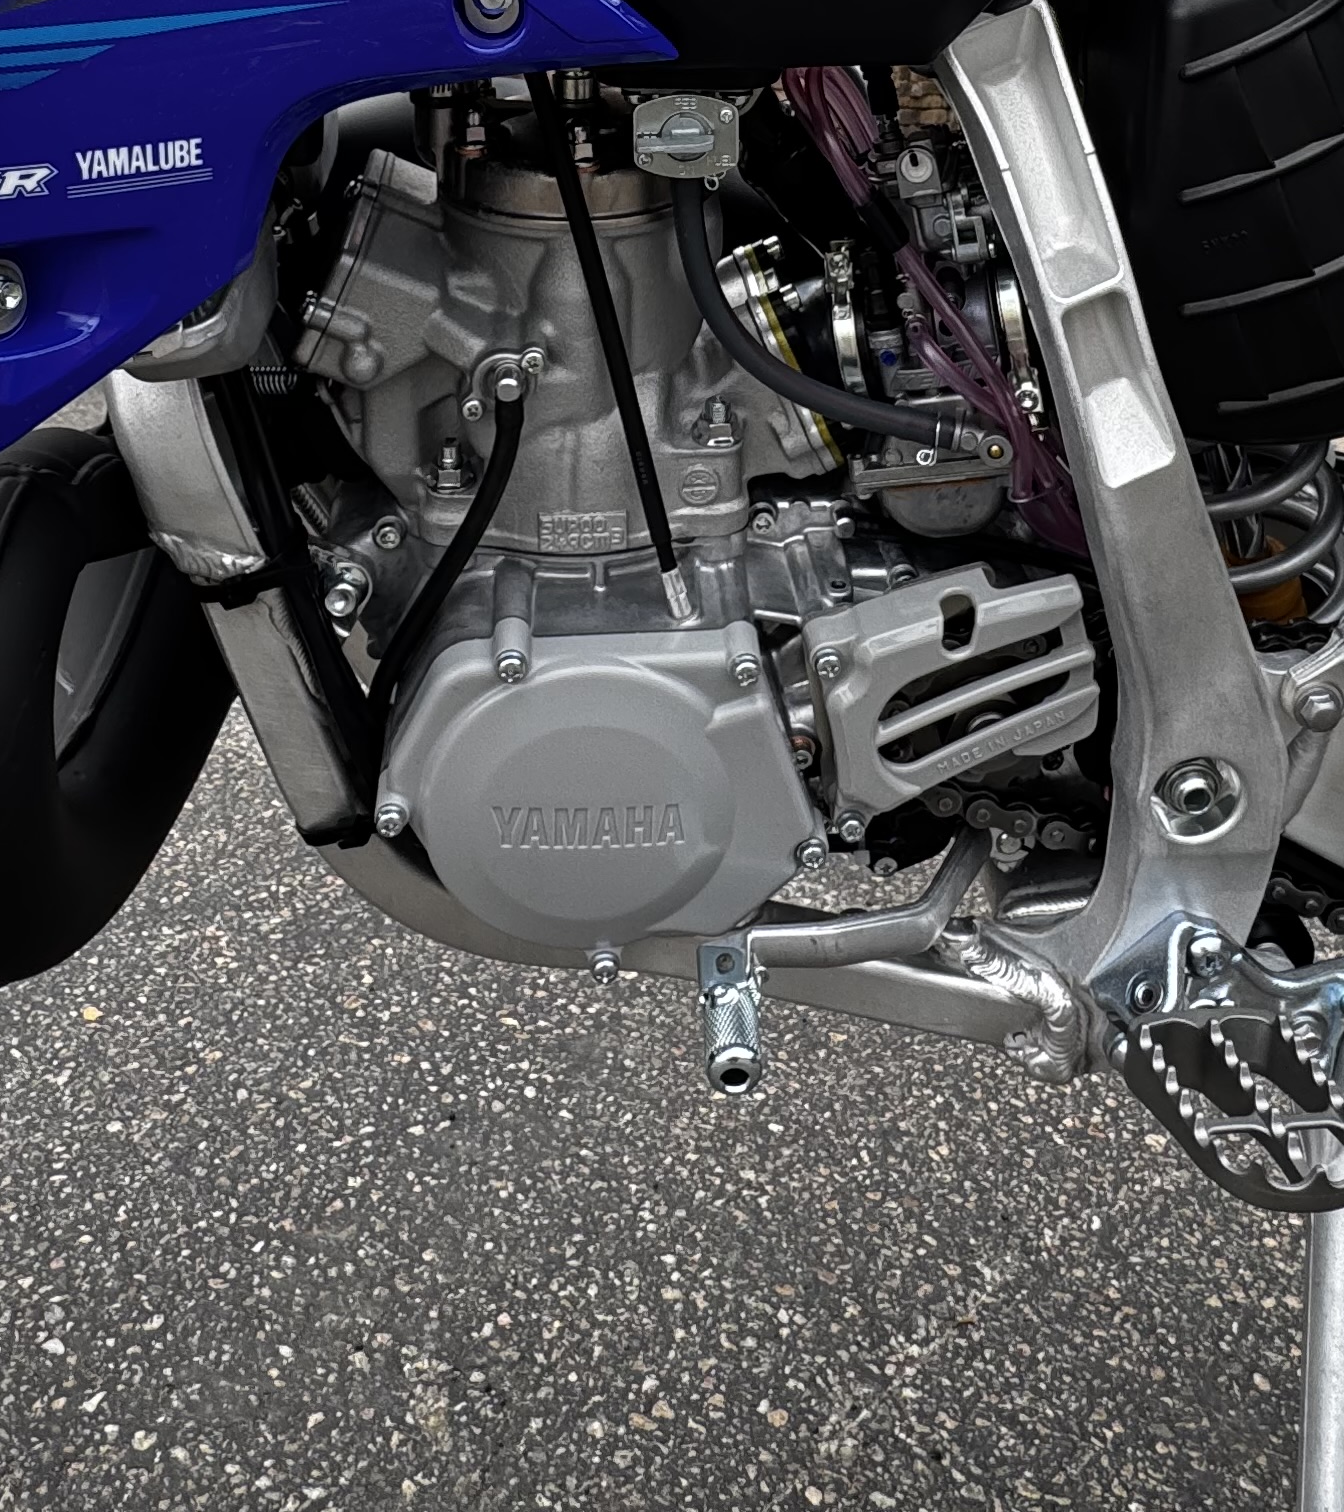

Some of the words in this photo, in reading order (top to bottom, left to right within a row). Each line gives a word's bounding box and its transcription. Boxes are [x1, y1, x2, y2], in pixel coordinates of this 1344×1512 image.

[75, 137, 204, 181] YAMALUBE
[937, 746, 983, 775] MADE
[988, 736, 1006, 752] IN
[1014, 710, 1066, 741] JAPAN
[491, 803, 685, 849] YAMAHA
